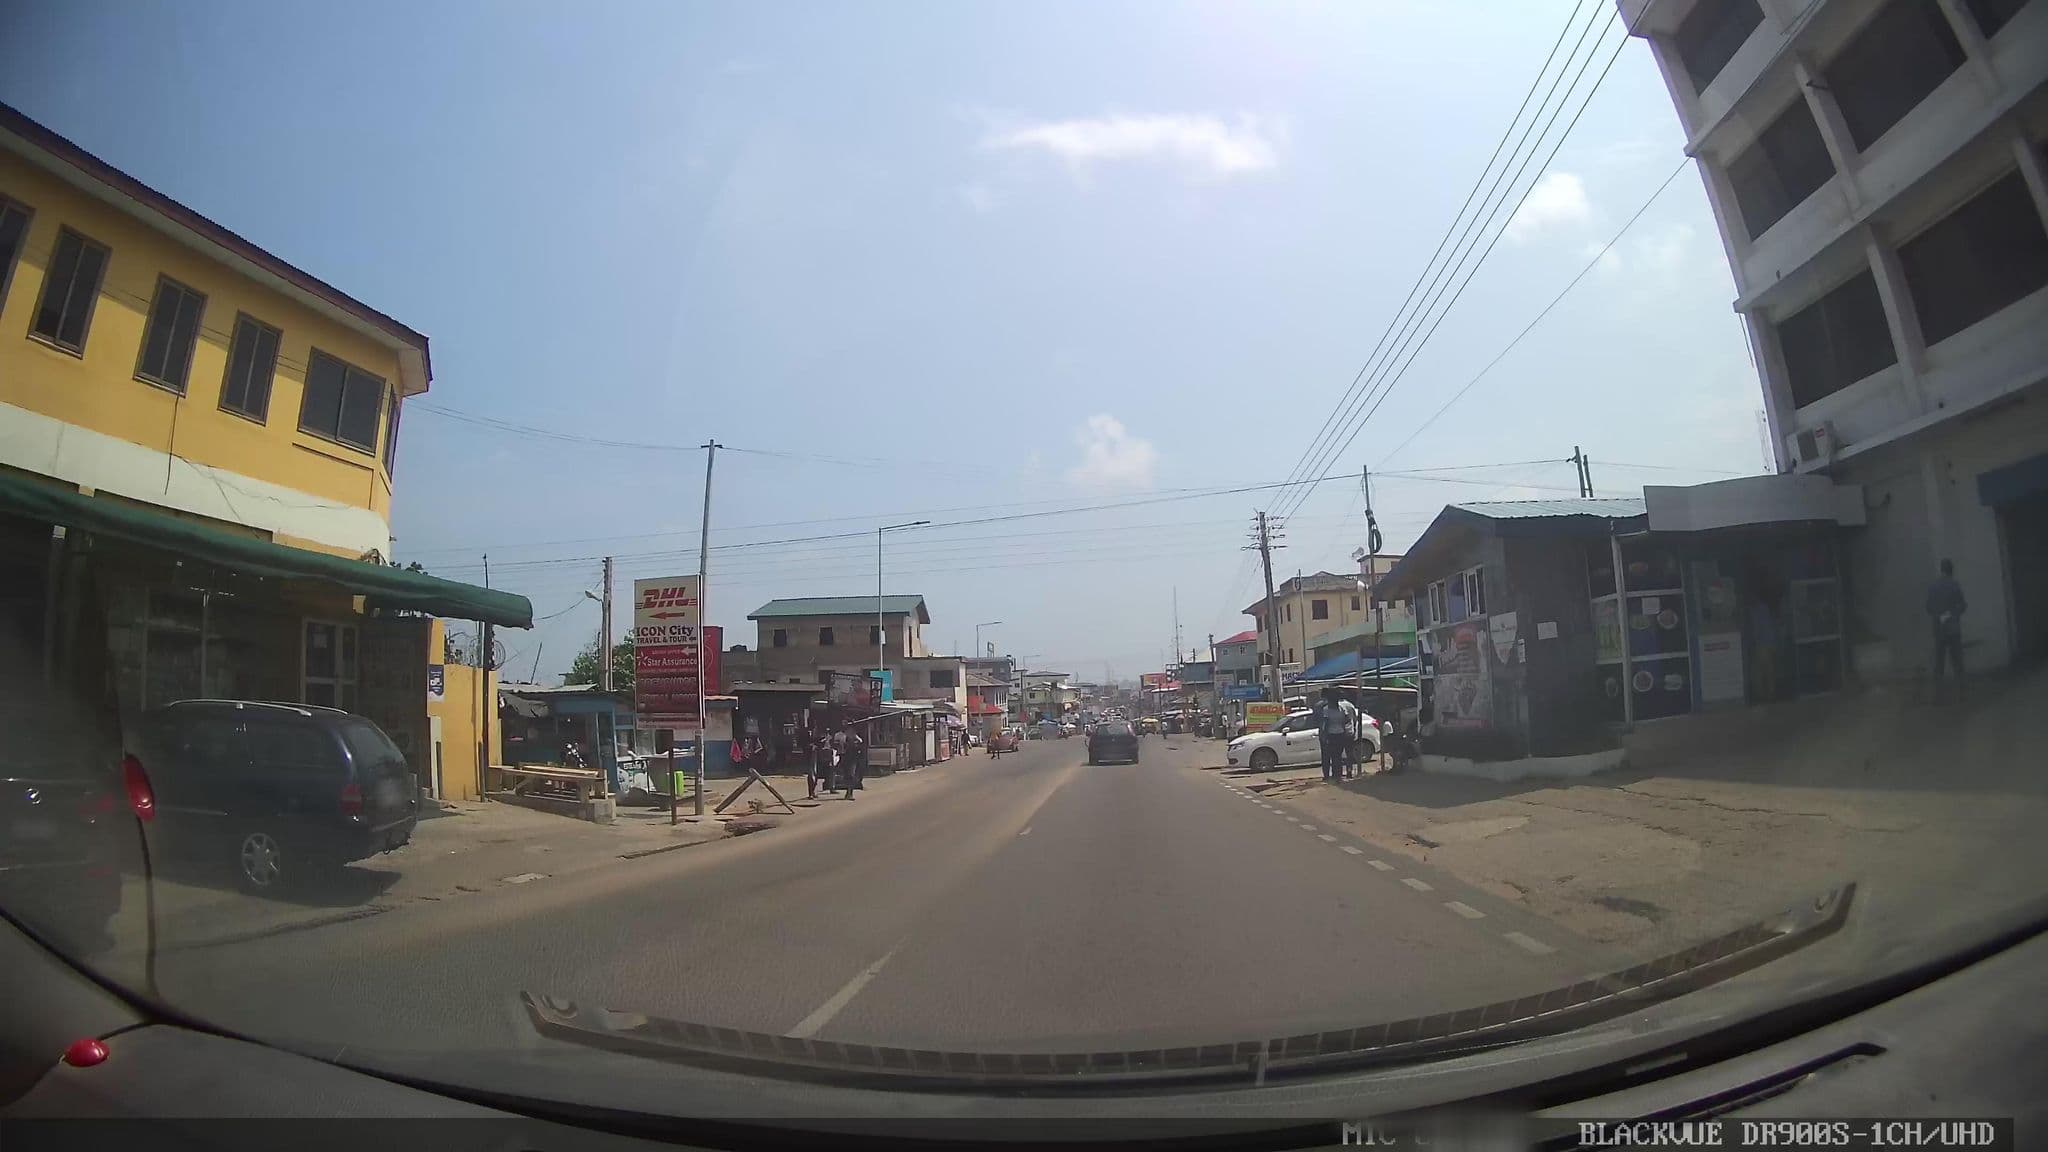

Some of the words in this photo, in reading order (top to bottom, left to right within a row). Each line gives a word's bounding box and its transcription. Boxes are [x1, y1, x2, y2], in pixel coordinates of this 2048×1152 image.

[643, 586, 689, 609] DHL
[636, 625, 666, 637] ICON
[669, 625, 694, 637] City
[637, 636, 662, 645] TRAVEL
[647, 658, 661, 666] Star
